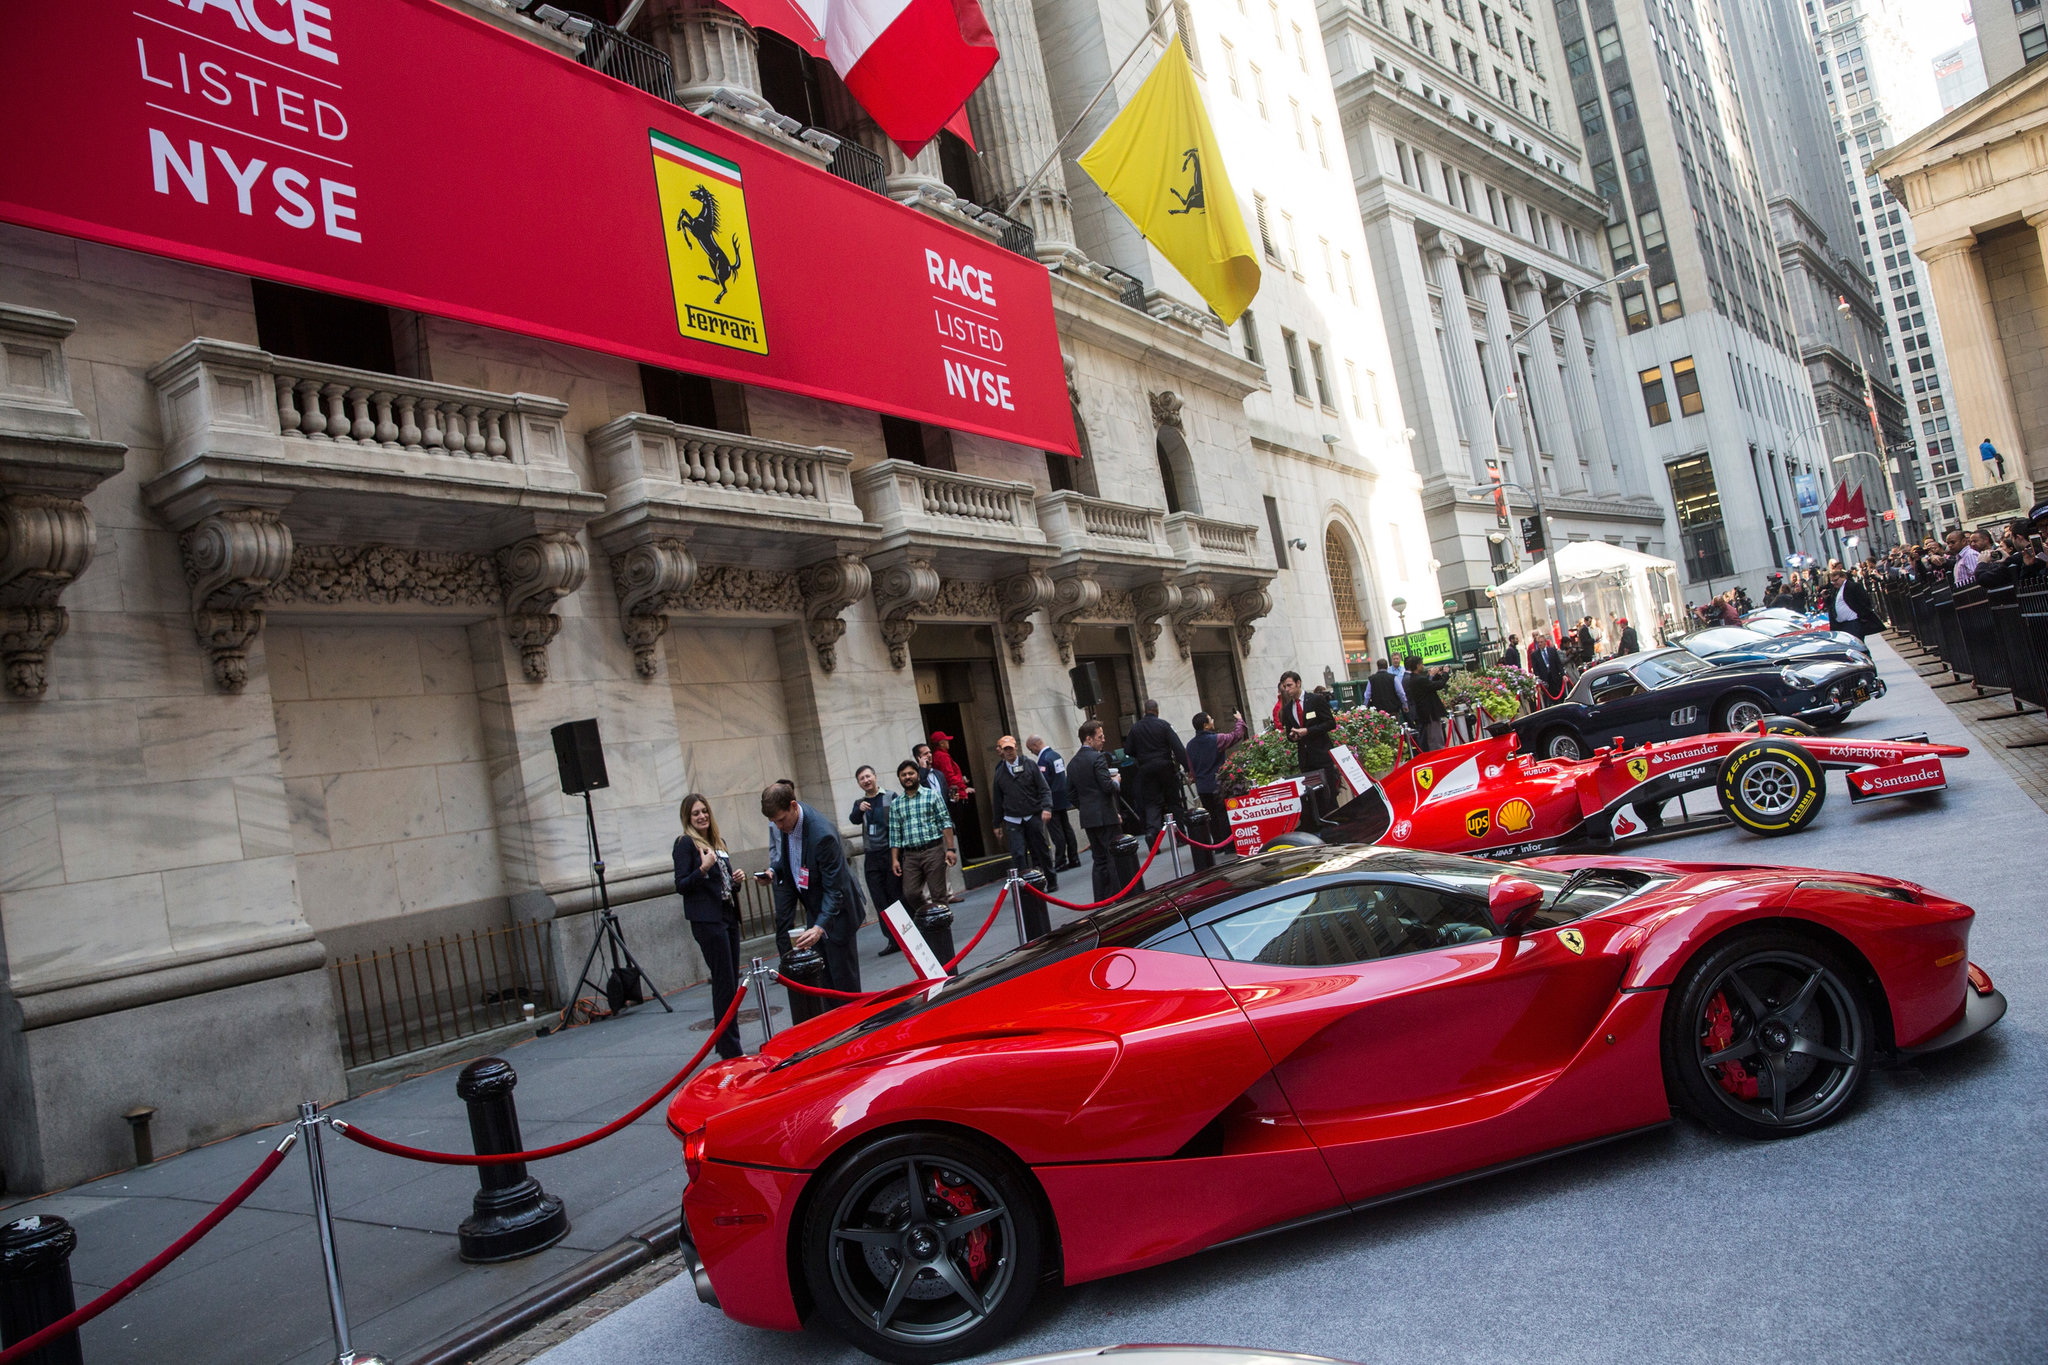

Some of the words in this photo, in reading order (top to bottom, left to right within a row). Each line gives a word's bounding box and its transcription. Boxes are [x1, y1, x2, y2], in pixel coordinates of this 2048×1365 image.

[168, 0, 339, 65] CE
[136, 36, 349, 142] LISTED
[148, 126, 363, 245] NYSE
[924, 247, 997, 308] RACE
[684, 303, 759, 344] Ferrari
[934, 309, 1004, 352] LISTED
[943, 358, 1016, 412] NYSE
[1409, 633, 1427, 644] YOUR
[1424, 642, 1451, 658] APPLE.
[1663, 743, 1719, 762] Santander
[1829, 744, 1891, 759] KASPERSKY
[1523, 766, 1551, 777] HUBLOT
[1668, 766, 1706, 780] WEICHAI
[1725, 747, 1762, 785] ZERO
[1873, 768, 1940, 789] Santander
[1725, 788, 1736, 801] P
[1242, 802, 1294, 820] Santander
[1790, 789, 1817, 824] PIRELLI
[1467, 815, 1490, 835] ups
[1236, 836, 1262, 847] MAHLE
[1520, 843, 1542, 853] infor
